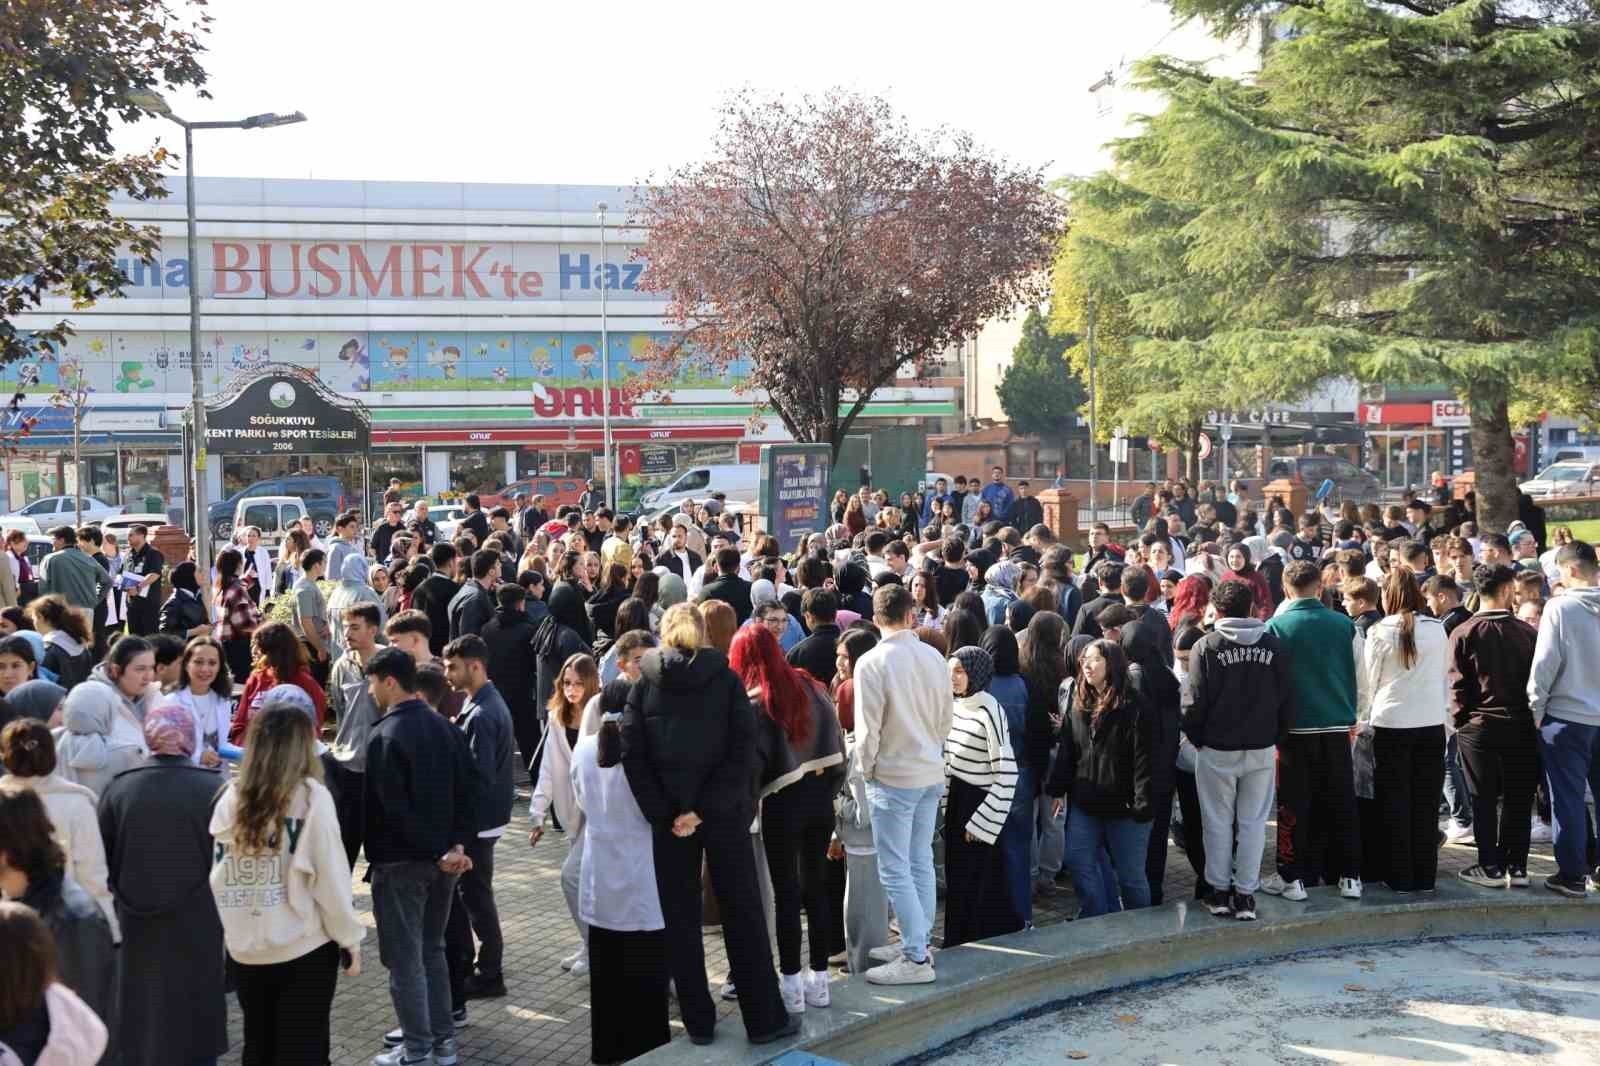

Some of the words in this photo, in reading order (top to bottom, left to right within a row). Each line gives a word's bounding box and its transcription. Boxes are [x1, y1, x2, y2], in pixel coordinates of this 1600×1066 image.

[249, 413, 316, 426] SOĞUKKUYU
[204, 429, 234, 439] KENT
[235, 429, 266, 439] PARKI
[267, 431, 279, 439] ve
[280, 430, 308, 439] SPOR
[309, 428, 357, 440] TESİSLERİ
[272, 442, 294, 451] 2006
[223, 854, 282, 887] 1991
